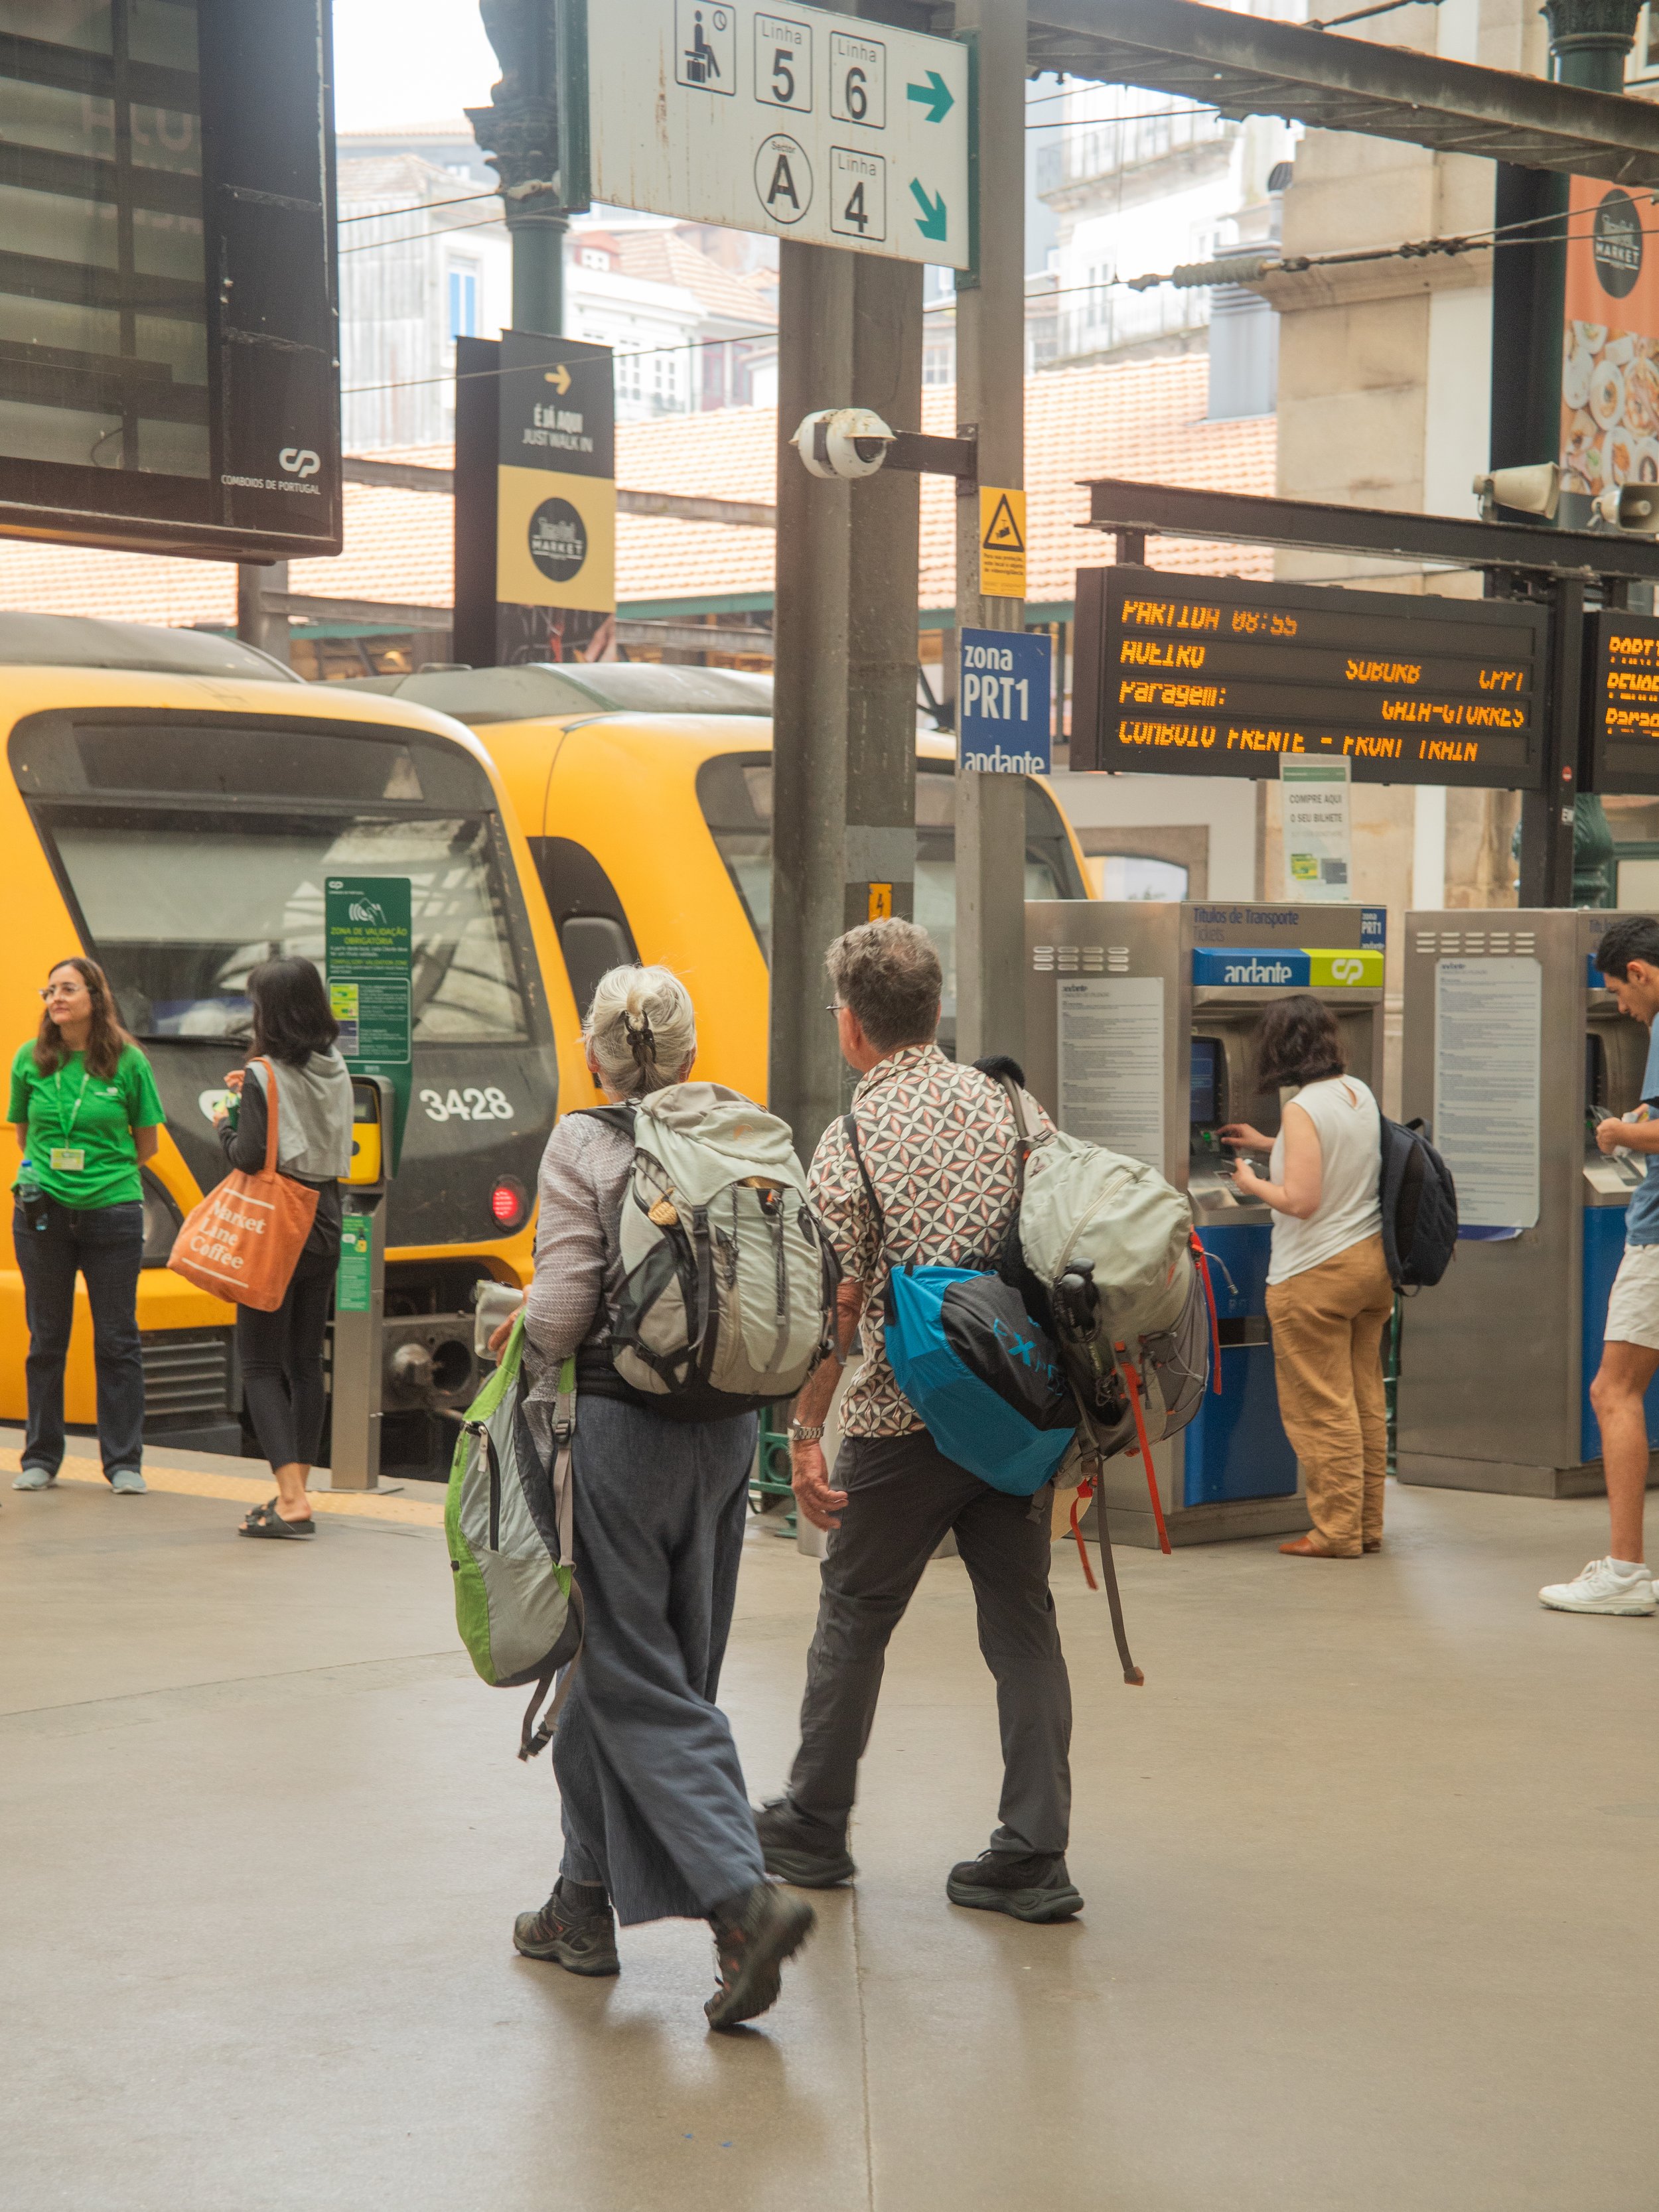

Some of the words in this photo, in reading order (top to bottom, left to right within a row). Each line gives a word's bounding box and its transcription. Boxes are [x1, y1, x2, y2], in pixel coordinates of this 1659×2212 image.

[762, 20, 802, 44] Linha
[838, 38, 877, 62] Linha
[772, 48, 794, 103] 5
[846, 67, 867, 120] 6
[771, 141, 796, 154] Sector
[838, 153, 877, 176] Linha
[767, 155, 800, 209] A
[845, 181, 868, 233] 4
[1595, 243, 1640, 265] MARKET
[522, 428, 548, 446] JUST
[220, 474, 264, 489] COMBOIOS
[265, 480, 276, 490] DE
[278, 481, 321, 494] PORTUGAL
[532, 540, 582, 555] MARKET
[964, 645, 1013, 671] zona
[1609, 636, 1659, 666] PART
[964, 673, 1029, 721] PRT1
[965, 744, 1045, 774] andante
[1289, 794, 1322, 803] COMPRE
[1325, 794, 1342, 805] AQUI
[1297, 813, 1312, 823] SEU
[1314, 813, 1342, 823] BILHETE
[1230, 906, 1242, 924] de
[1246, 908, 1299, 928] Transporte
[1362, 922, 1382, 934] PRT1
[1224, 958, 1292, 984] andante
[419, 1087, 514, 1122] 3428
[212, 1200, 266, 1235] Market
[199, 1217, 238, 1245] Lane
[190, 1235, 244, 1269] Coffee
